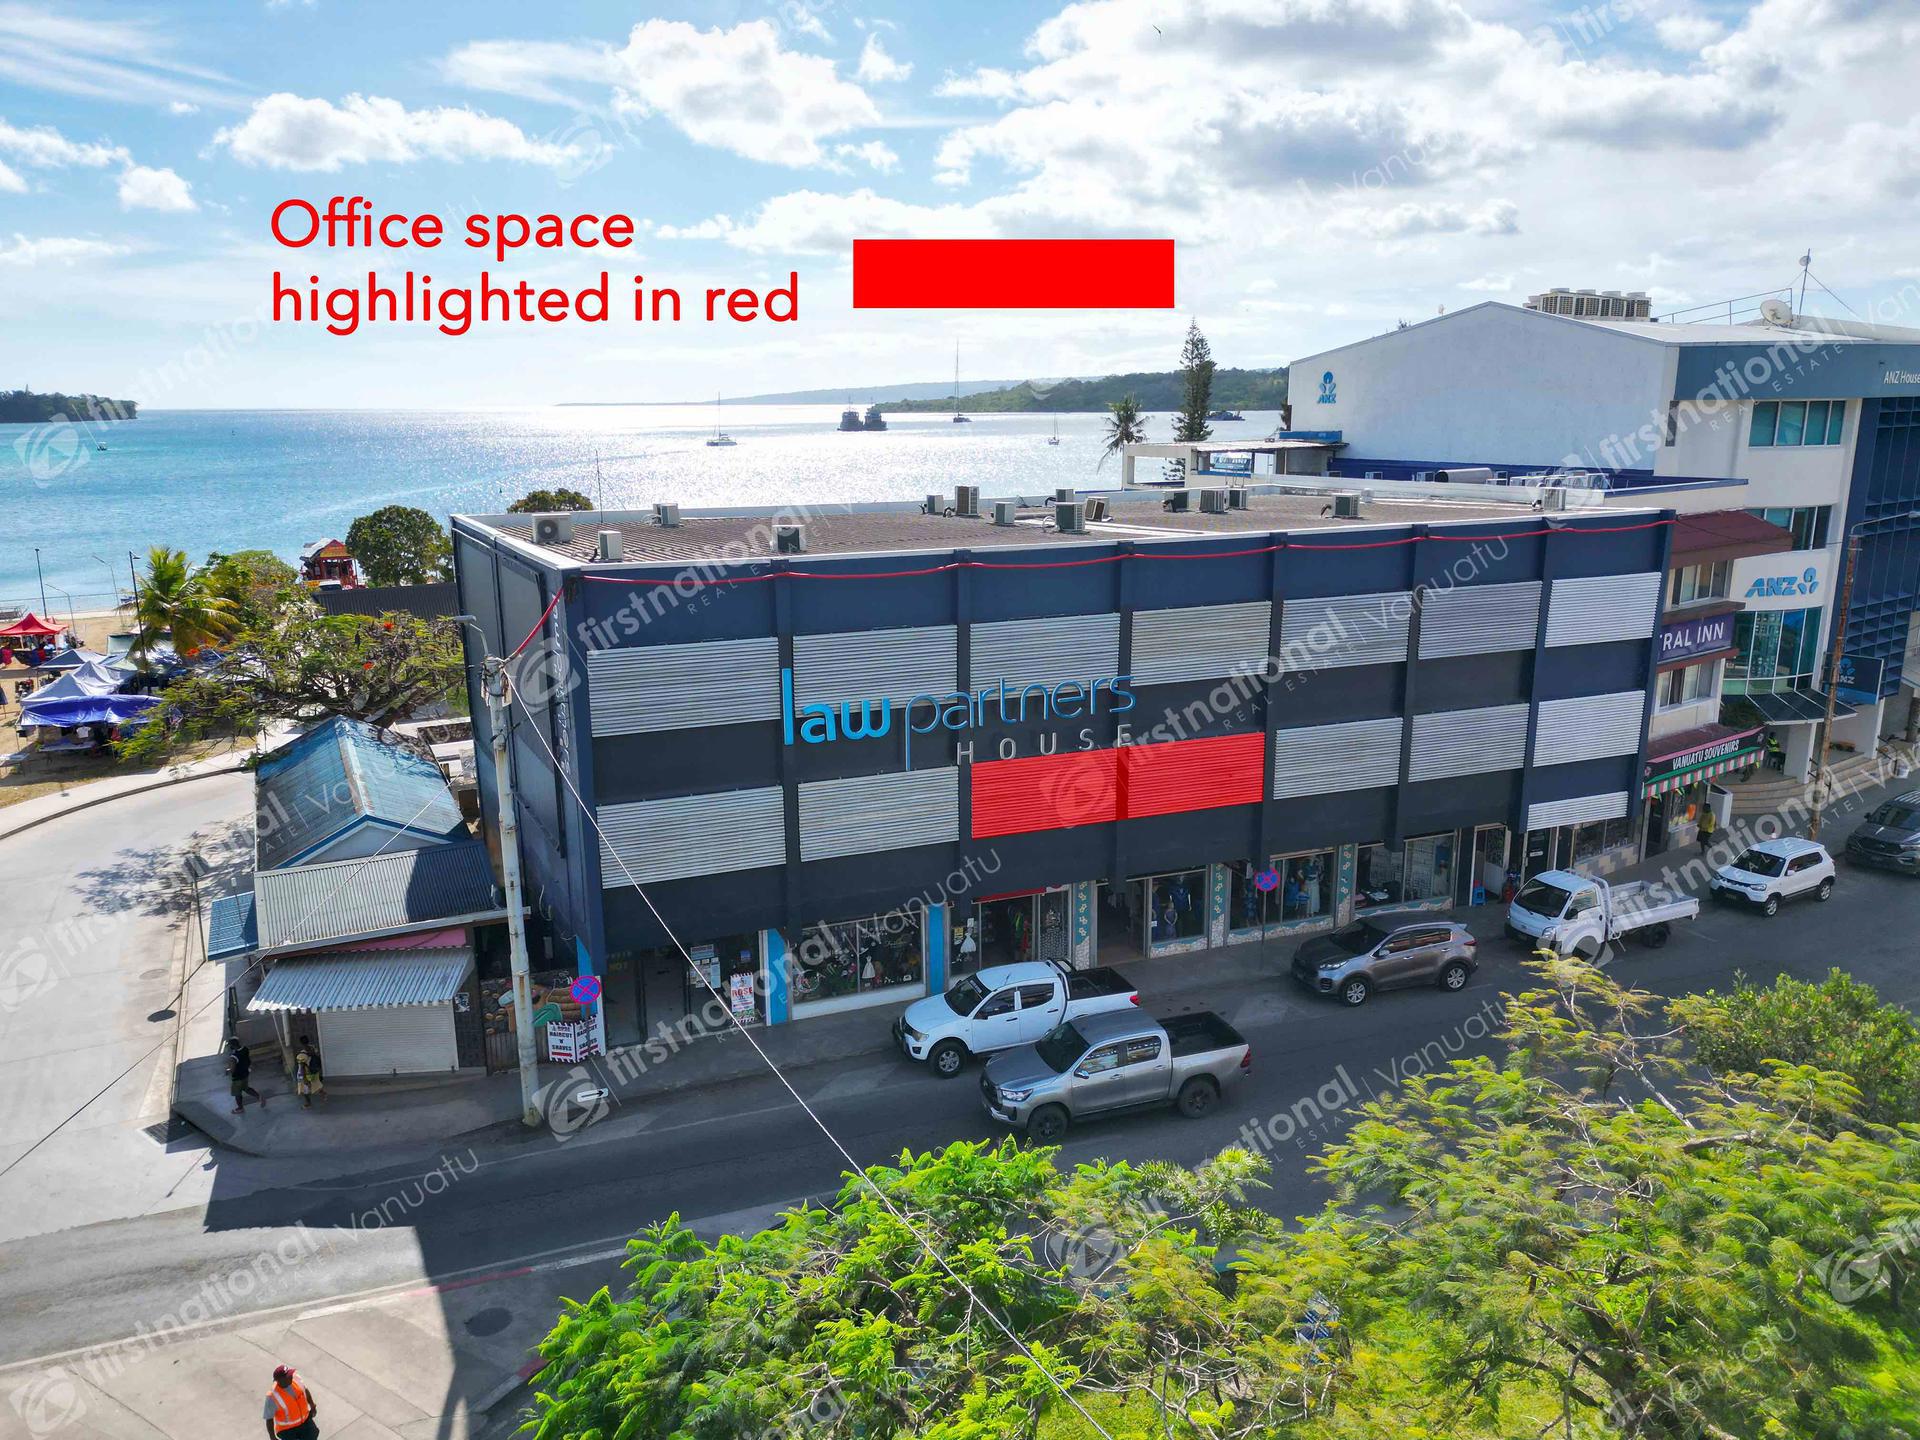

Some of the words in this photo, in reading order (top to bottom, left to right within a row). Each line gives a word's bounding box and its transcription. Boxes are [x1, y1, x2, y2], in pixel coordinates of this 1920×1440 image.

[1883, 371, 1900, 384] ANZ
[1745, 576, 1798, 598] ANZ
[1659, 629, 1692, 651] RAL
[1697, 622, 1725, 644] INN
[781, 667, 891, 746] law
[905, 675, 1136, 772] partners
[956, 723, 1134, 766] HOUSE
[1672, 750, 1703, 771] VANUATU
[1704, 739, 1740, 762] SOUVENIRS
[731, 986, 753, 998] ROSE
